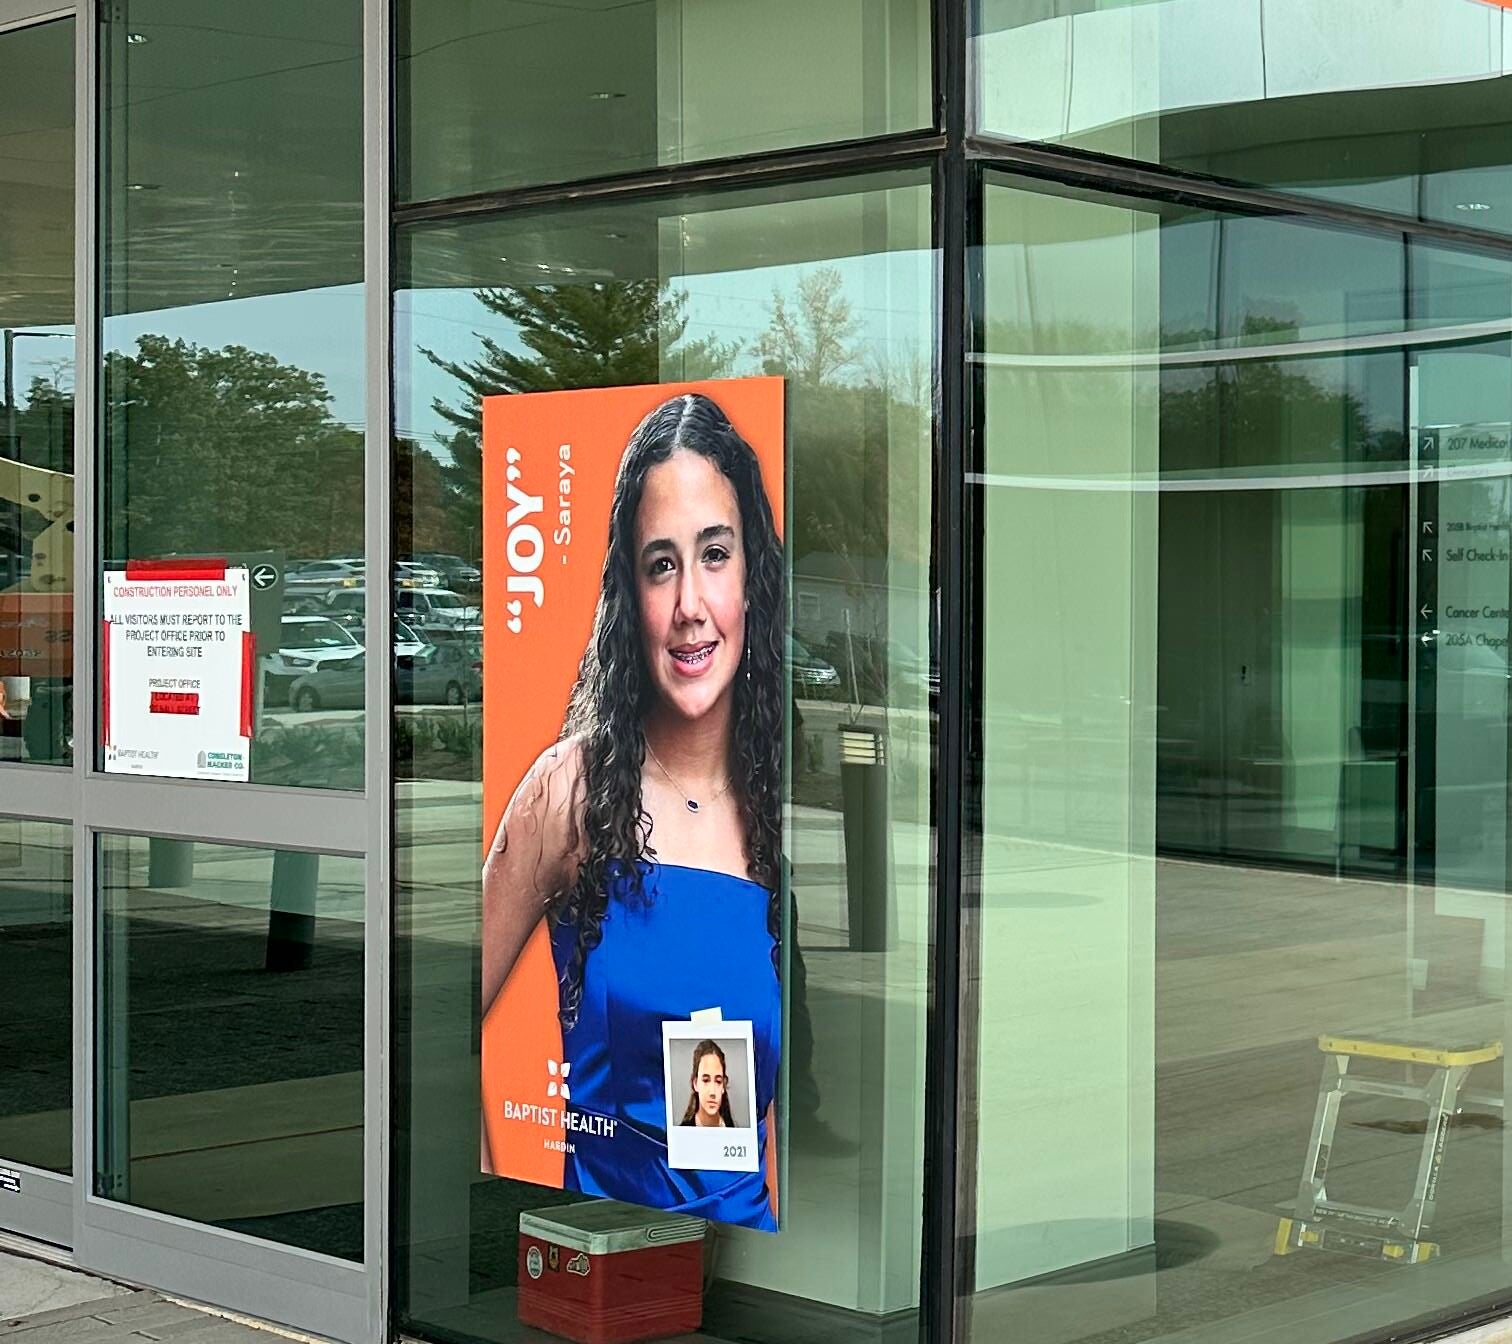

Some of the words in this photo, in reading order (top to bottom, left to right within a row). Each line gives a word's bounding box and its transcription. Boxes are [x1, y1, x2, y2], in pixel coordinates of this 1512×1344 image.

[1447, 437, 1467, 451] 207
[554, 444, 576, 545] Saraya
[506, 447, 545, 634] “JOY”
[1446, 547, 1464, 562] Self
[113, 586, 171, 597] CONSTRUCTION
[216, 585, 238, 597] ONLY
[1445, 605, 1480, 618] Cancer
[110, 614, 124, 625] ALL
[125, 614, 158, 625] VISITORS
[160, 614, 180, 625] MUST
[182, 614, 213, 625] REPORT
[215, 614, 226, 625] TO
[227, 614, 243, 625] THE
[125, 630, 159, 641] PROJECT
[161, 630, 188, 641] OFFICE
[189, 630, 213, 641] PRIOR
[215, 630, 226, 641] TO
[1445, 632, 1473, 647] 205A
[147, 645, 184, 657] ENTERING
[186, 646, 203, 657] SITE
[504, 1100, 558, 1127] BAPTIST
[543, 1138, 576, 1154] HARDIN
[723, 1145, 748, 1158] 2021
